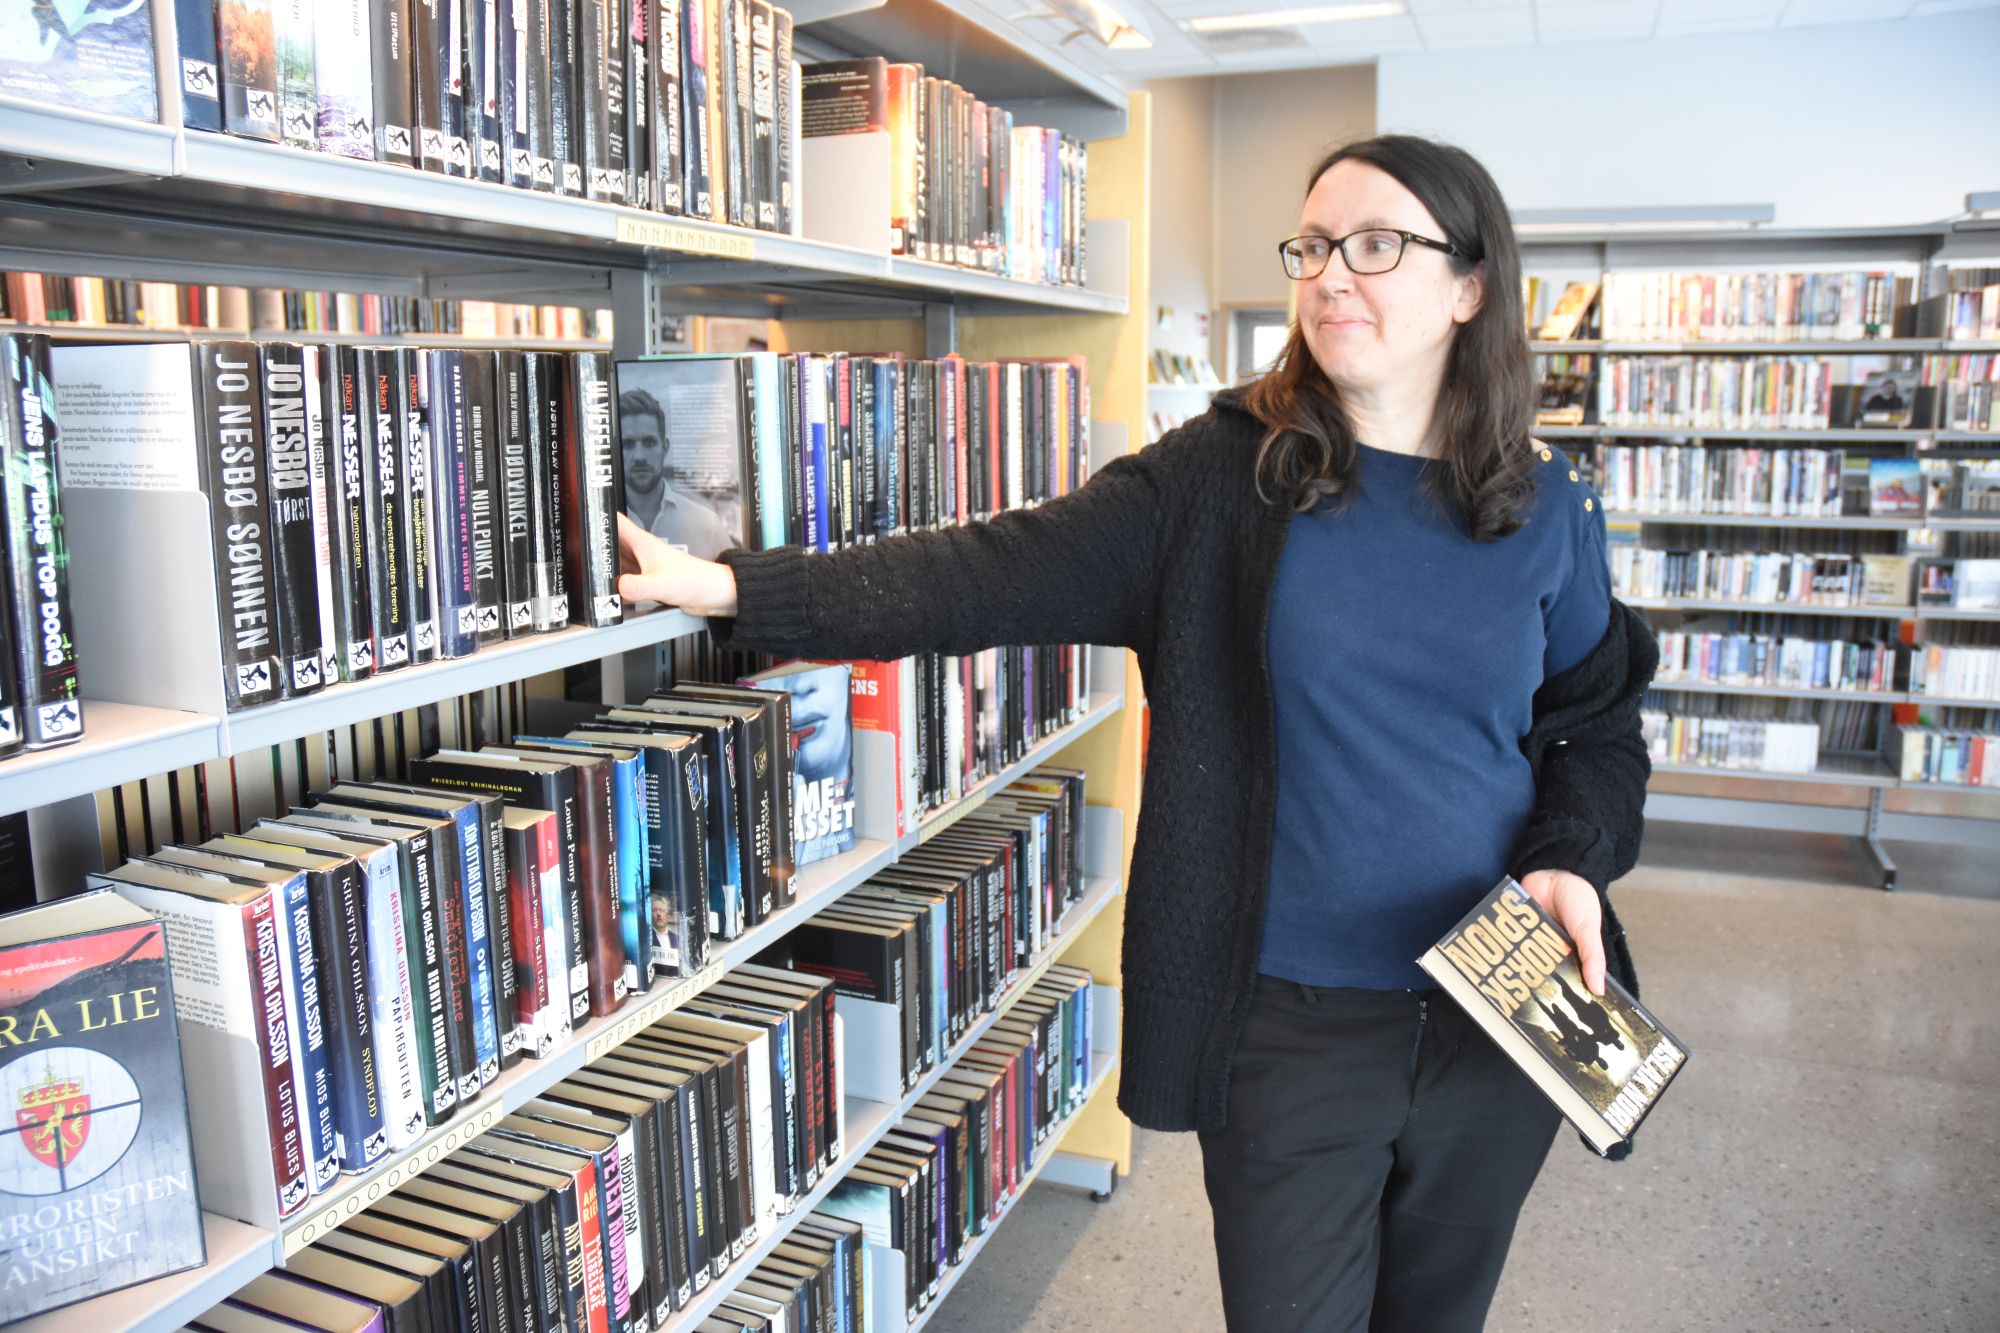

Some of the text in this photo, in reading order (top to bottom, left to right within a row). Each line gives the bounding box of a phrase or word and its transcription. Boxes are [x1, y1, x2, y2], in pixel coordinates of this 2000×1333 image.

[266, 359, 310, 490] JO NESBØ
[408, 374, 424, 492] håkan NESSER
[215, 354, 270, 650] JO NESBØ SØNNEN
[342, 374, 362, 568] håkan NESSER halvmorderen
[378, 374, 399, 624] håkan NESSER de venstrehendtes forening
[458, 462, 466, 510] HIMMEL
[472, 406, 494, 580] BJØRN OLAV NORDAHL NULLPUNKT
[505, 444, 526, 542] DØDVINKEL
[552, 474, 560, 524] NORDAHL
[806, 465, 816, 512] ECLIPSE
[22, 388, 64, 667] JENS LAPIDUS TOP DOGG
[274, 496, 310, 524] TØRST
[460, 513, 468, 542] OVER
[462, 546, 470, 591] LONDON
[600, 510, 613, 579] ASLAK NORE
[417, 854, 430, 910] KRISTINA
[493, 848, 501, 892] BIRKELAND
[564, 798, 580, 943] Louise Penny NÅDELØS
[390, 892, 404, 955] KRISTINA
[422, 911, 436, 965] OHLSSON
[444, 900, 457, 944] Små
[464, 823, 492, 1049] JON OVERVAKET
[500, 895, 508, 925] LYSTEN
[530, 864, 545, 995] Louise Penny SKJULTE
[1446, 890, 1540, 982] SPION
[293, 906, 315, 979] KRISTINA
[502, 941, 511, 958] DET
[1479, 922, 1572, 1018] NORSK
[78, 986, 162, 1032] LIE
[342, 877, 377, 1118] KRISTINA OHLSSON SYNDFLOD
[398, 961, 411, 1021] OHLSSON
[502, 958, 515, 998] ONDE
[256, 917, 300, 1177] KRISTINA OHLSSON LOTUS BLUES
[302, 979, 323, 1052] OHLSSON
[392, 996, 412, 1100] PAPIRGUTTEN
[1630, 1036, 1683, 1098] ASLAK
[315, 1068, 328, 1103] MIOS
[320, 1107, 332, 1152] BLUES
[727, 1124, 739, 1180] BROREN
[620, 1152, 638, 1237] ROBOTHAM
[695, 1192, 704, 1237] OFFERDYR
[2, 1229, 141, 1292] ANSIKT
[20, 1214, 119, 1260] UTEN
[564, 1222, 585, 1291] ANE RIEL
[603, 1146, 631, 1320] PETER ROBINSON
[492, 1256, 502, 1286] MARIT
[541, 1230, 558, 1315] MARIT REIERSGÅRD
[586, 1251, 601, 1311] LISELEJE
